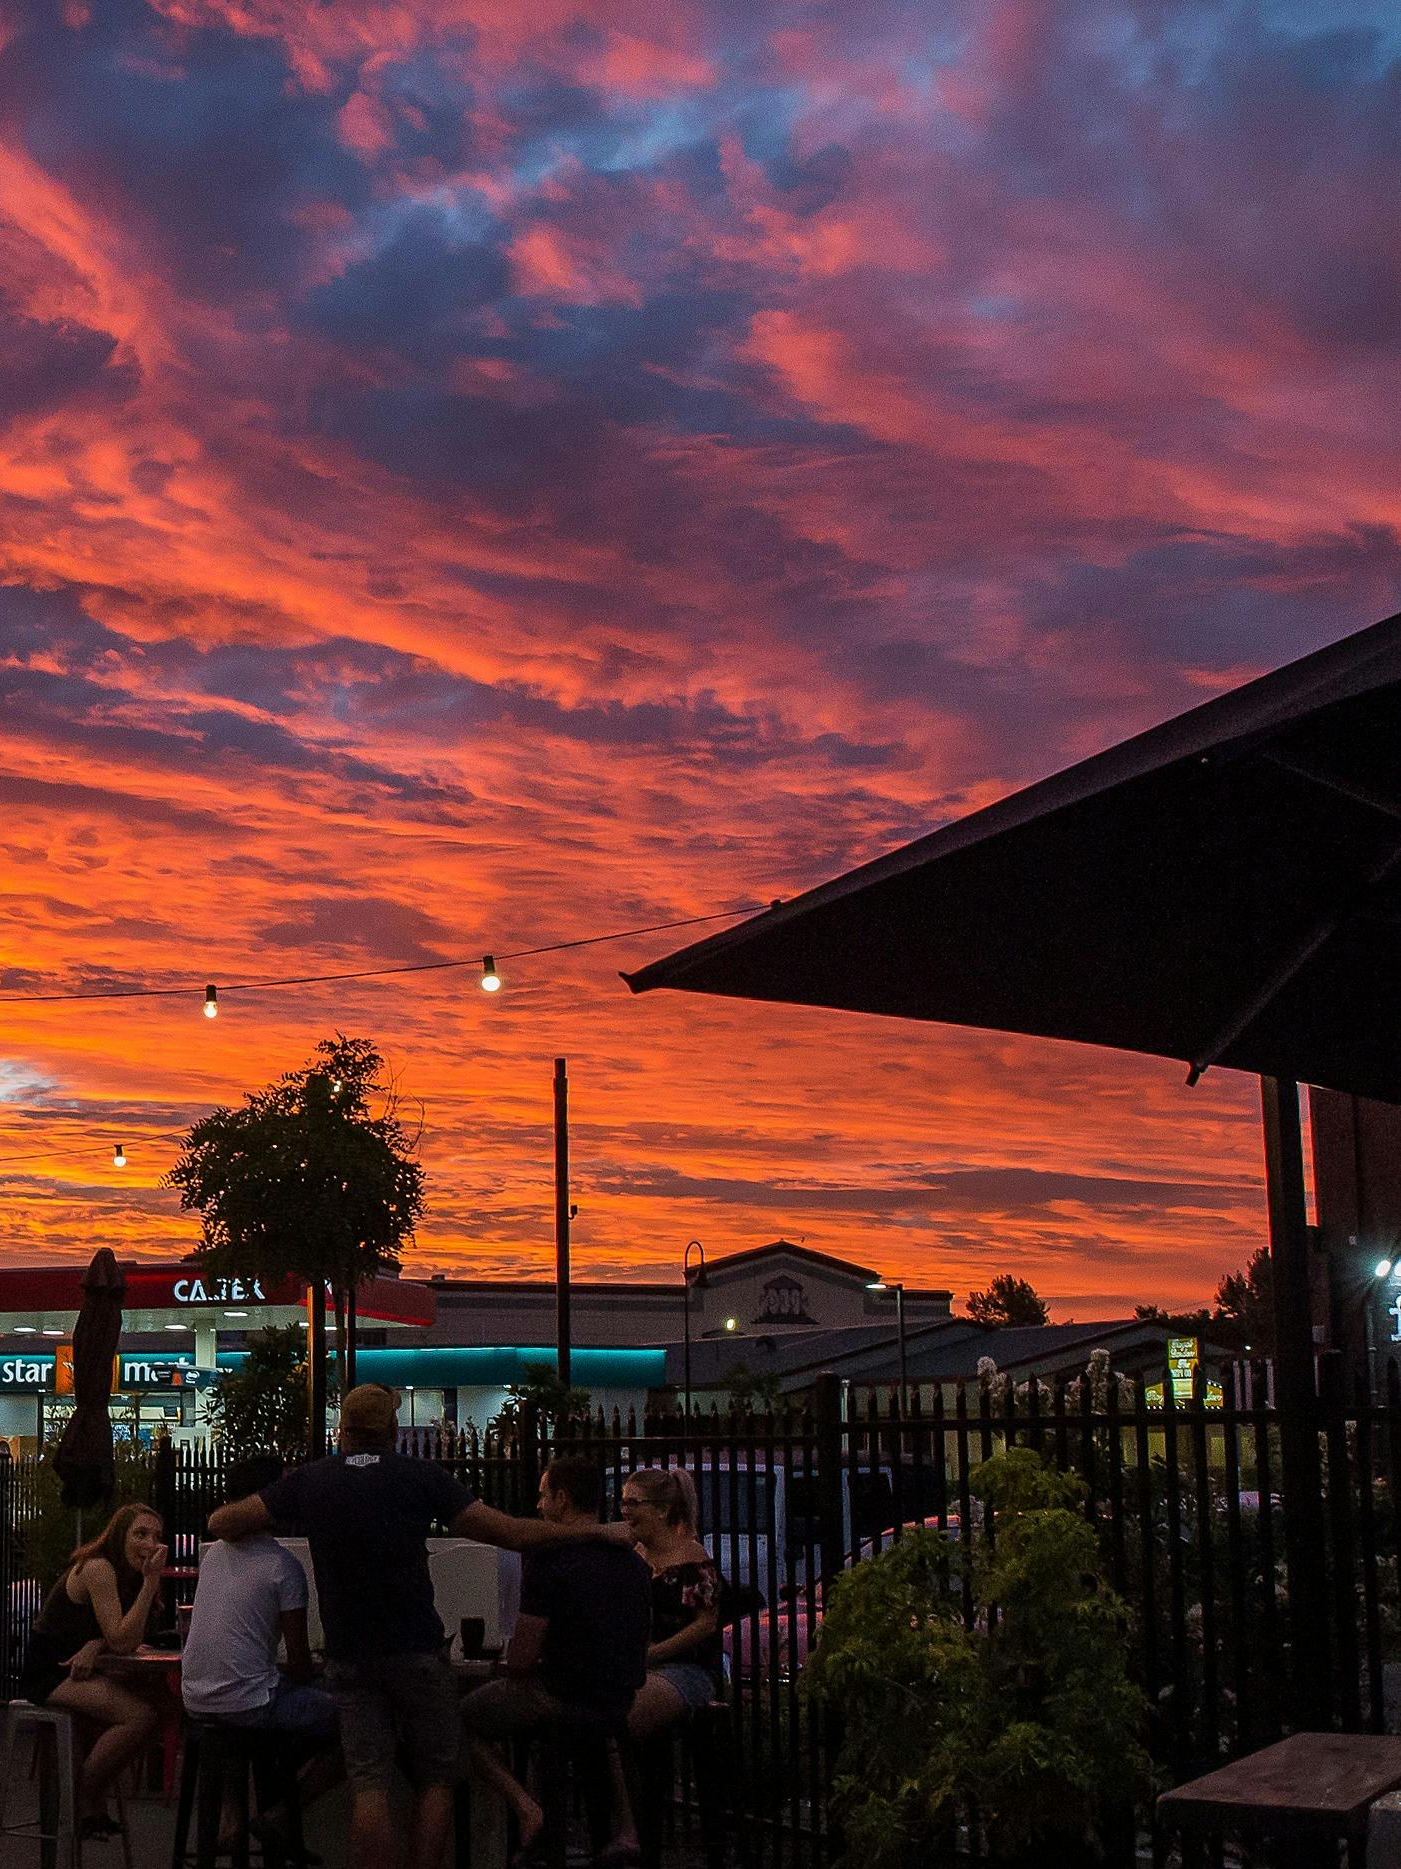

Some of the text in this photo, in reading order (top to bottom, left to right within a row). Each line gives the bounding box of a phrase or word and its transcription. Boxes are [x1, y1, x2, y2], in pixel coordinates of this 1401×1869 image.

[174, 1278, 266, 1302] CATEX
[2, 1359, 53, 1383] star
[124, 1357, 189, 1382] ma
